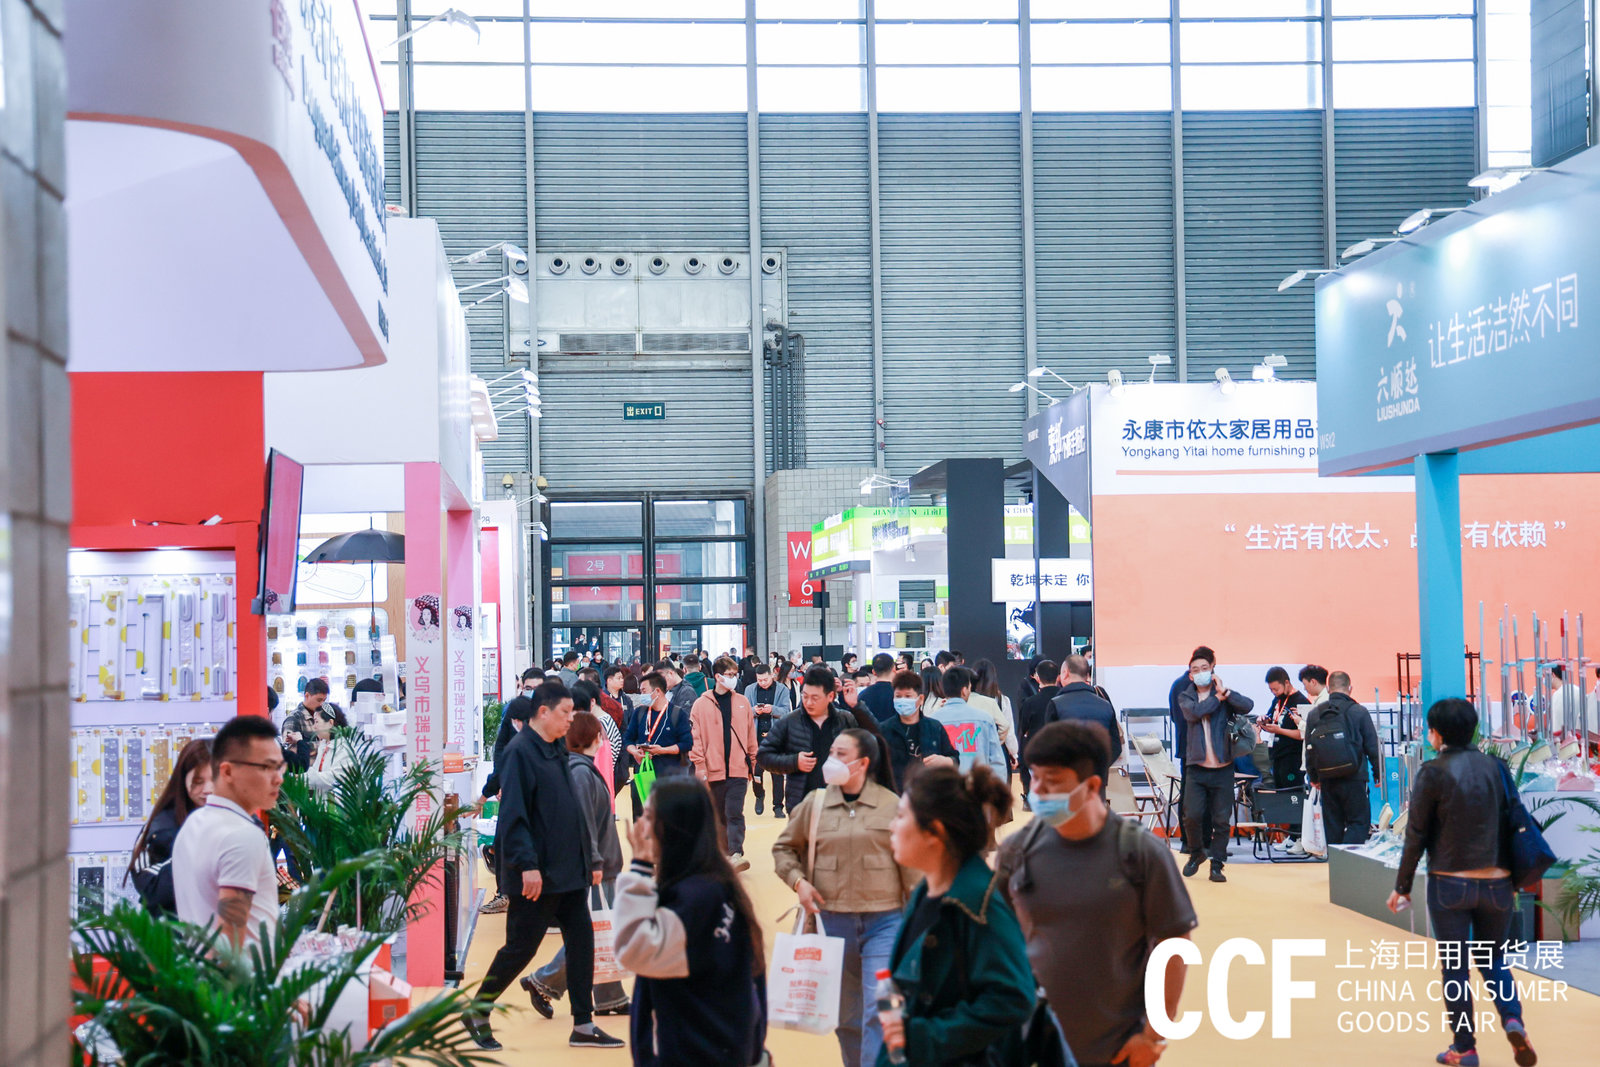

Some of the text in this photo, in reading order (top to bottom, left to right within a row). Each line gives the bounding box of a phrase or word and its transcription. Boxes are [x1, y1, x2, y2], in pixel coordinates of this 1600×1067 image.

[1428, 273, 1578, 368] 让生活洁然不同
[1377, 356, 1419, 404] 六顺达
[626, 405, 635, 417] 出
[635, 407, 653, 415] EXIT
[1376, 397, 1421, 423] LIUSHUNDA
[1121, 418, 1318, 441] 永康市依太家居用品
[1121, 446, 1180, 460] Yongkang
[1183, 446, 1208, 457] Yitai
[1211, 446, 1245, 457] home
[1248, 446, 1306, 459] furnishing
[586, 559, 605, 572] 2号
[1010, 573, 1090, 586] 乾坤未定 你
[801, 580, 814, 596] 6
